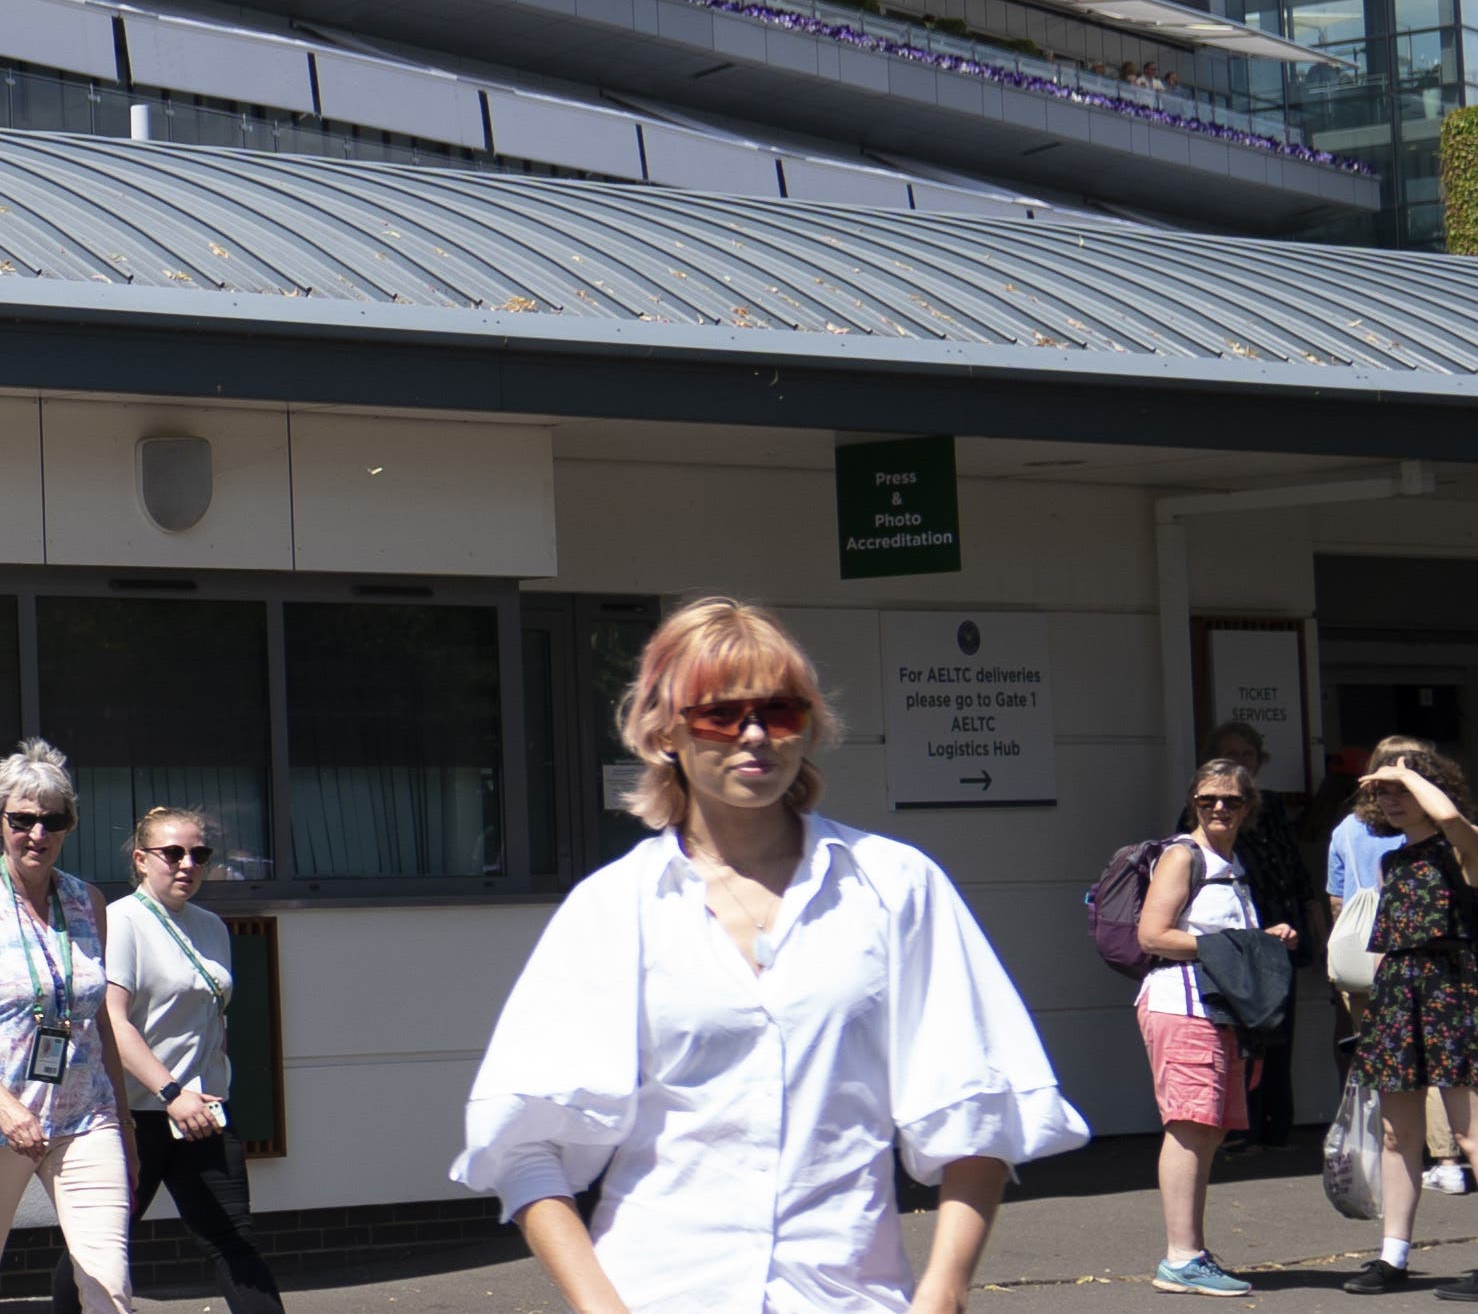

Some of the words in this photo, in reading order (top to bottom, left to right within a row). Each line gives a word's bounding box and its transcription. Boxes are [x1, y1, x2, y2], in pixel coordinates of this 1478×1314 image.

[875, 472, 917, 486] Press
[891, 491, 903, 506] &
[874, 513, 922, 528] Photo
[846, 531, 953, 551] Accreditation
[899, 666, 923, 683] For
[927, 666, 972, 683] AELTC
[976, 666, 1041, 683] deliveries
[906, 691, 951, 711] please
[955, 695, 973, 710] go
[977, 693, 991, 707] to
[996, 691, 1027, 707] Gate
[1030, 691, 1037, 707] 1
[1239, 686, 1279, 701] TICKET
[1232, 708, 1288, 722] SERVICES
[951, 716, 996, 732] AELTC
[928, 740, 989, 760] Logistics
[993, 740, 1021, 757] Hub
